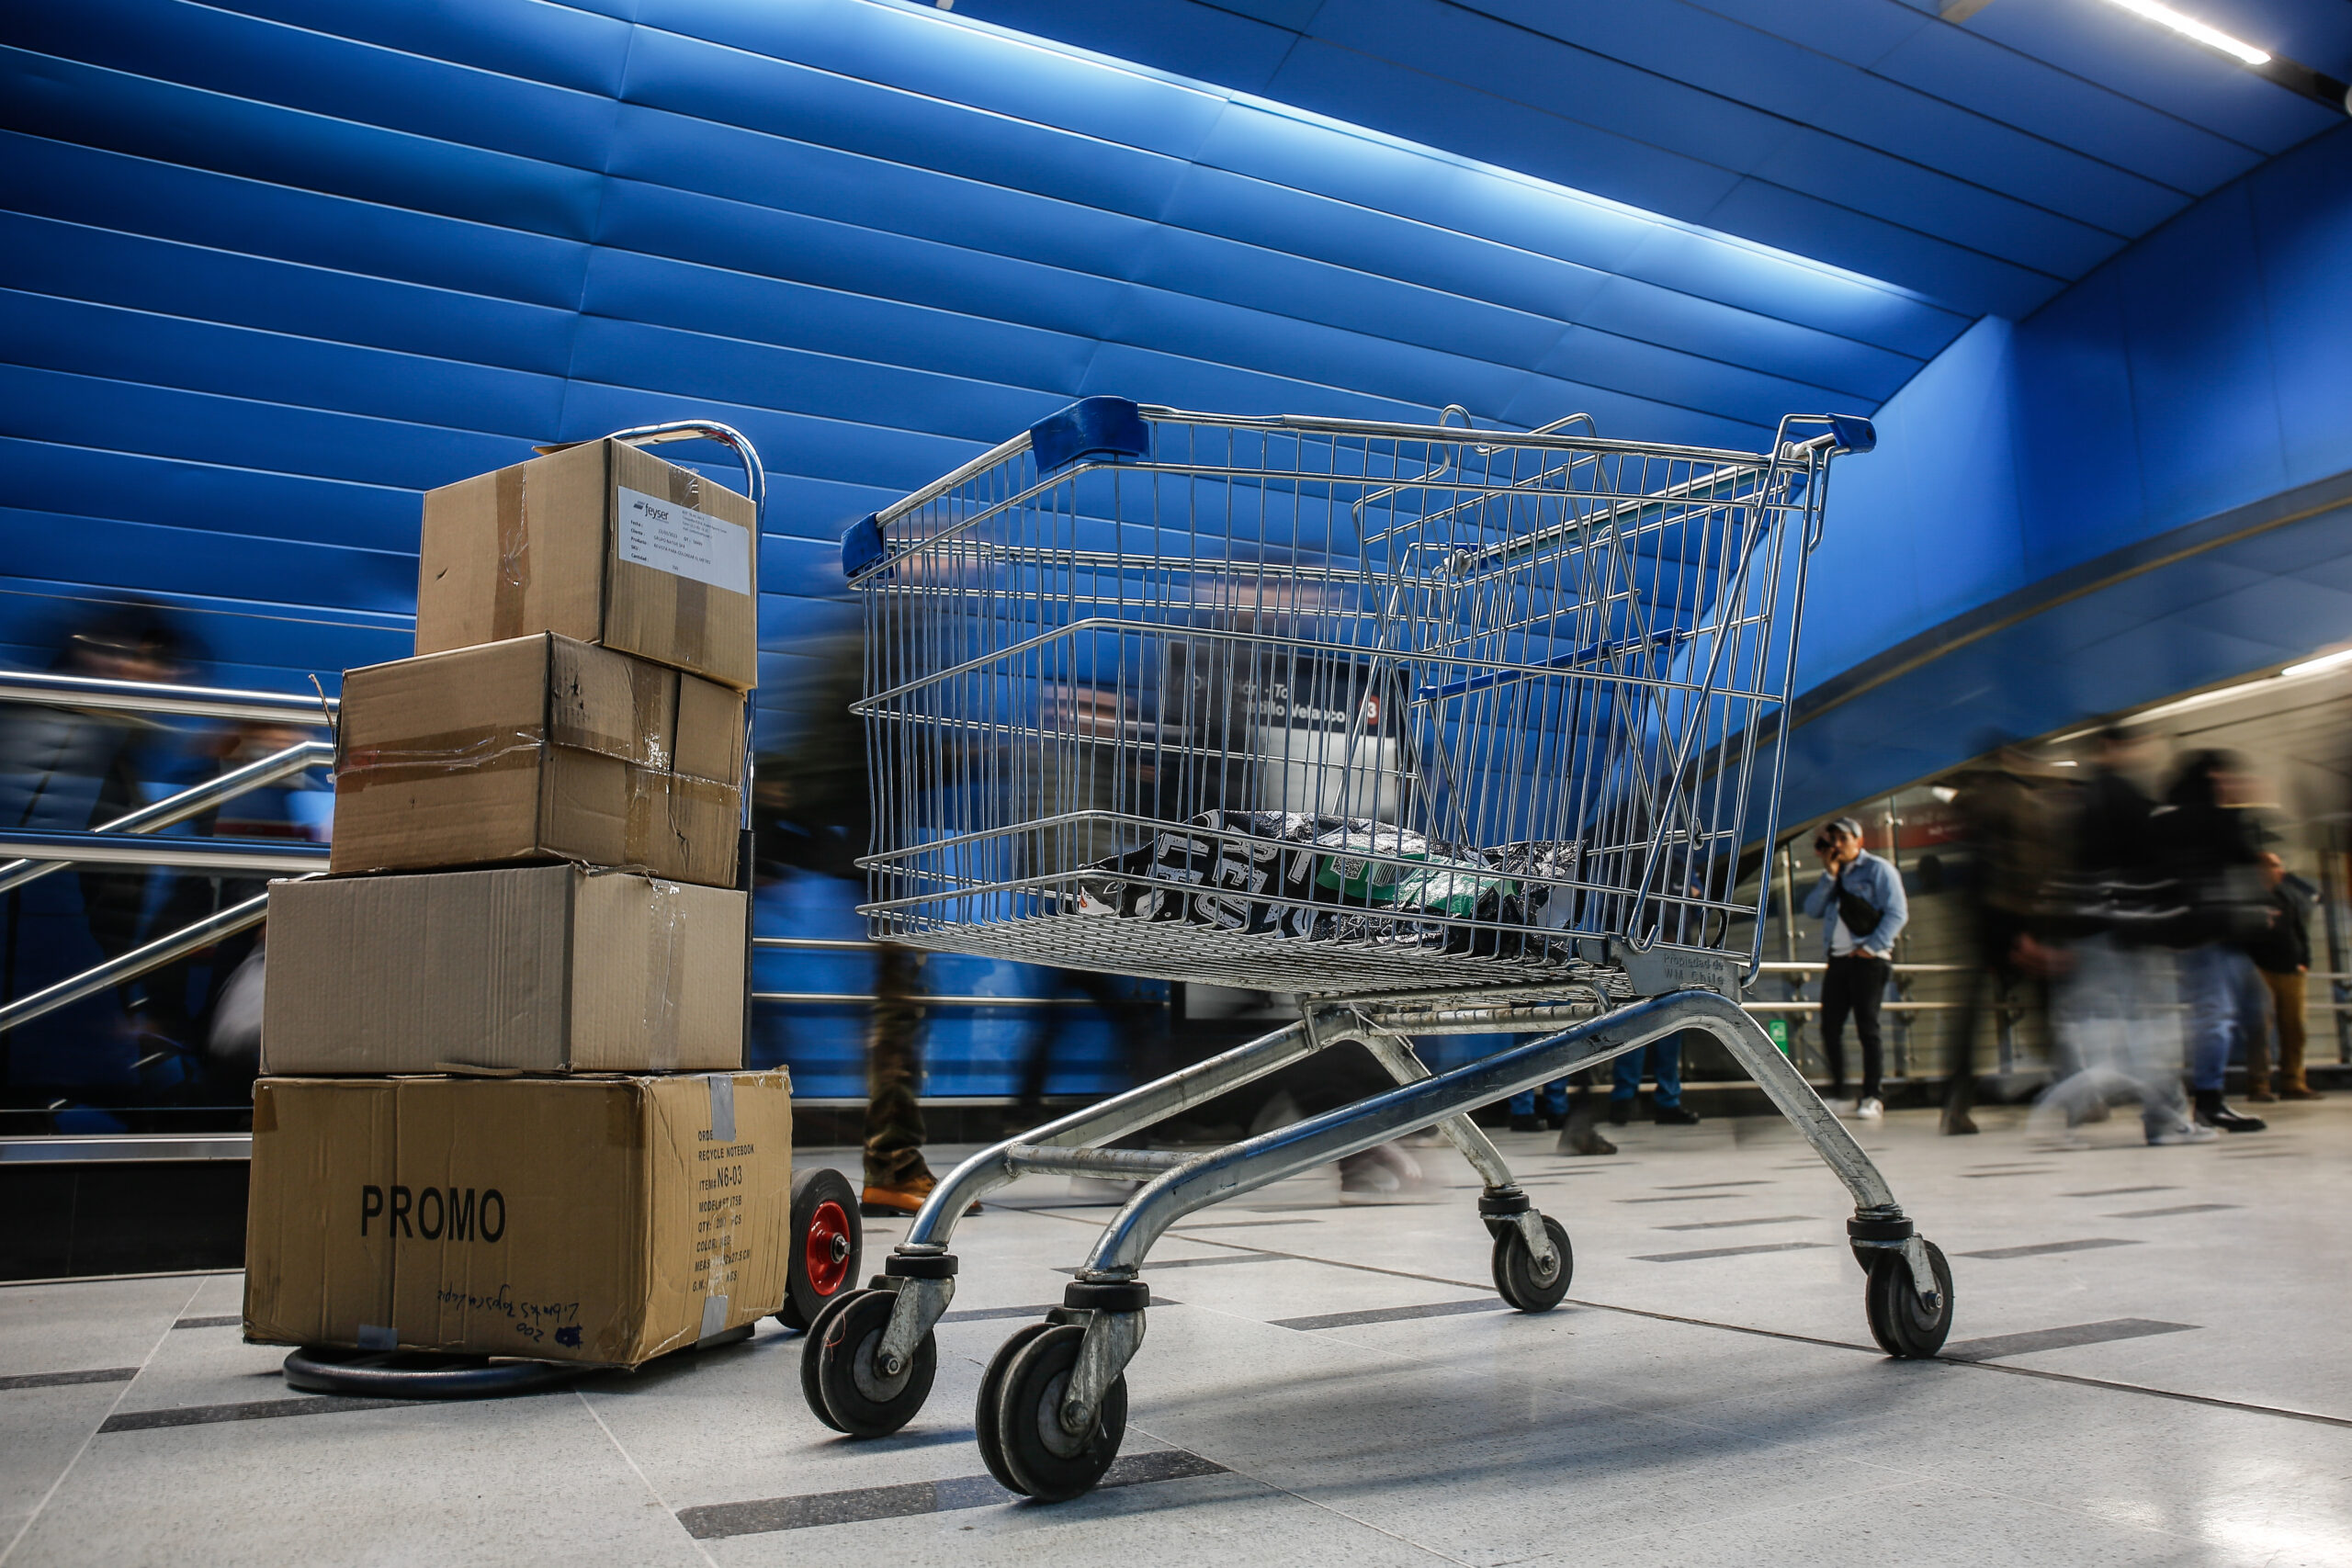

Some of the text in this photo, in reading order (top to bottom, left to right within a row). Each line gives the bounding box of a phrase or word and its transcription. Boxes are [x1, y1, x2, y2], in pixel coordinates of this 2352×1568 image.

[644, 502, 670, 521] feyser
[1367, 702, 1377, 718] 3
[1664, 953, 1724, 971] Propiedad de
[1691, 970, 1724, 986] Chile
[698, 1144, 755, 1161] RECYCLE NOTEBOOK
[361, 1185, 506, 1244] PROMO
[698, 1221, 712, 1234] QTY:
[696, 1238, 718, 1253] COLOR:
[516, 1323, 544, 1343] 200
